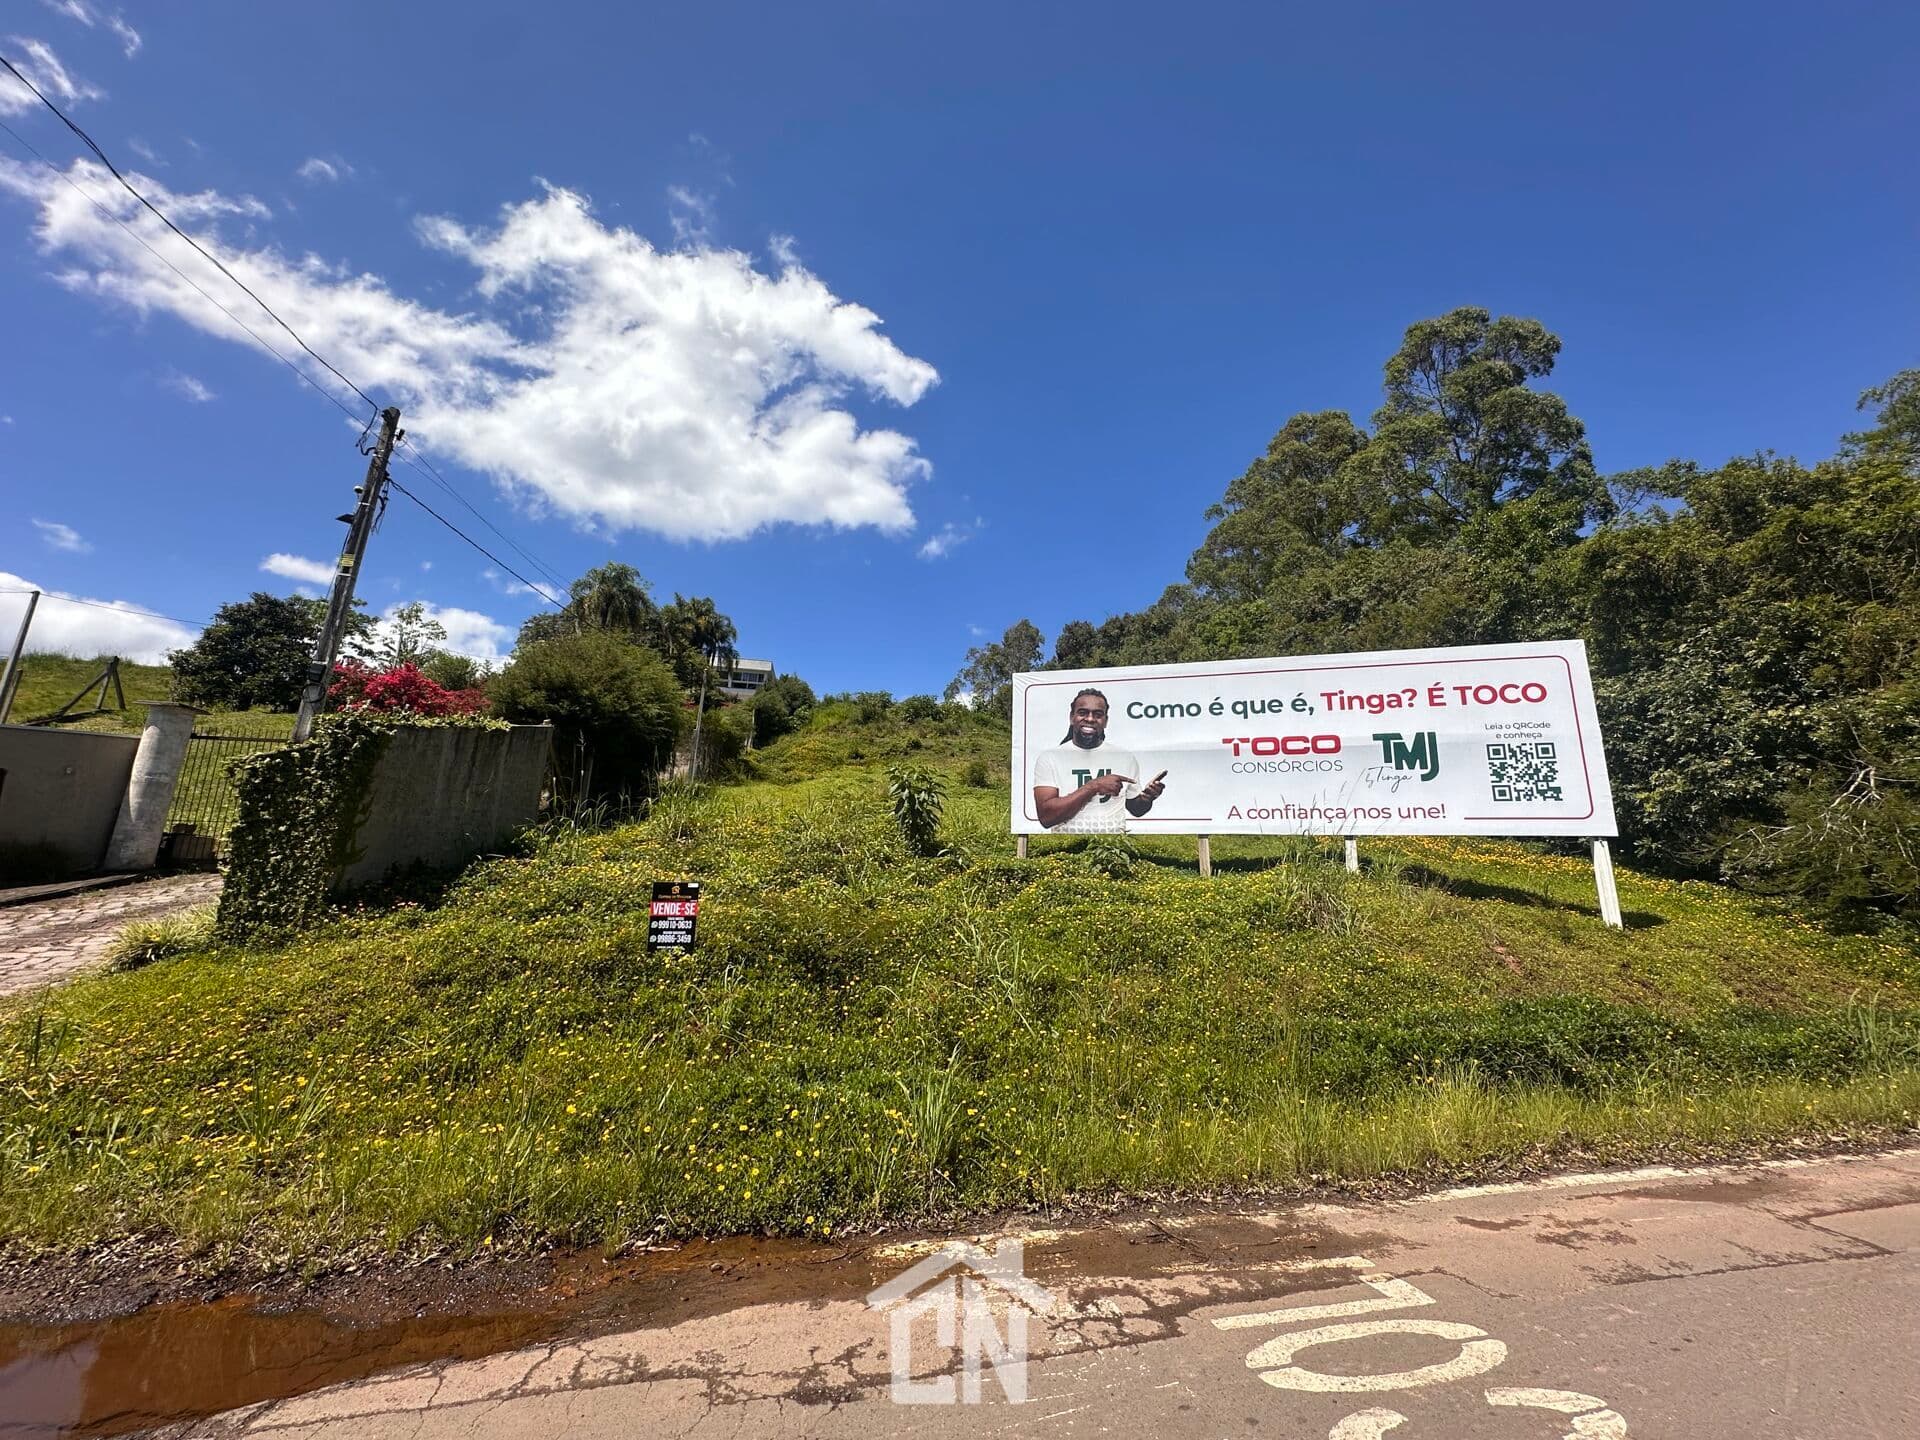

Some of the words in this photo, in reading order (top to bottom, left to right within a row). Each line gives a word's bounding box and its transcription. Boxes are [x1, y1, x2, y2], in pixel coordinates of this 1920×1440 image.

[1126, 701, 1202, 720] Como
[1208, 697, 1225, 717] é
[1231, 698, 1284, 720] que
[1291, 692, 1315, 716] é,
[1320, 688, 1419, 715] Tinga?
[1428, 681, 1448, 708] É
[1453, 683, 1548, 707] TOCO
[1485, 722, 1504, 731] Leia
[1513, 721, 1551, 730] QRCode
[1503, 731, 1543, 741] conheça
[1222, 734, 1342, 757] TOCO
[1373, 731, 1440, 782] TMJ
[1231, 759, 1344, 775] CONSÓRCIOS
[1369, 766, 1414, 793] Tinga
[1228, 805, 1242, 820] A
[1247, 802, 1347, 825] confiança
[1354, 805, 1392, 820] nos
[1398, 803, 1447, 820] une!
[653, 902, 696, 916] VENDE-SE
